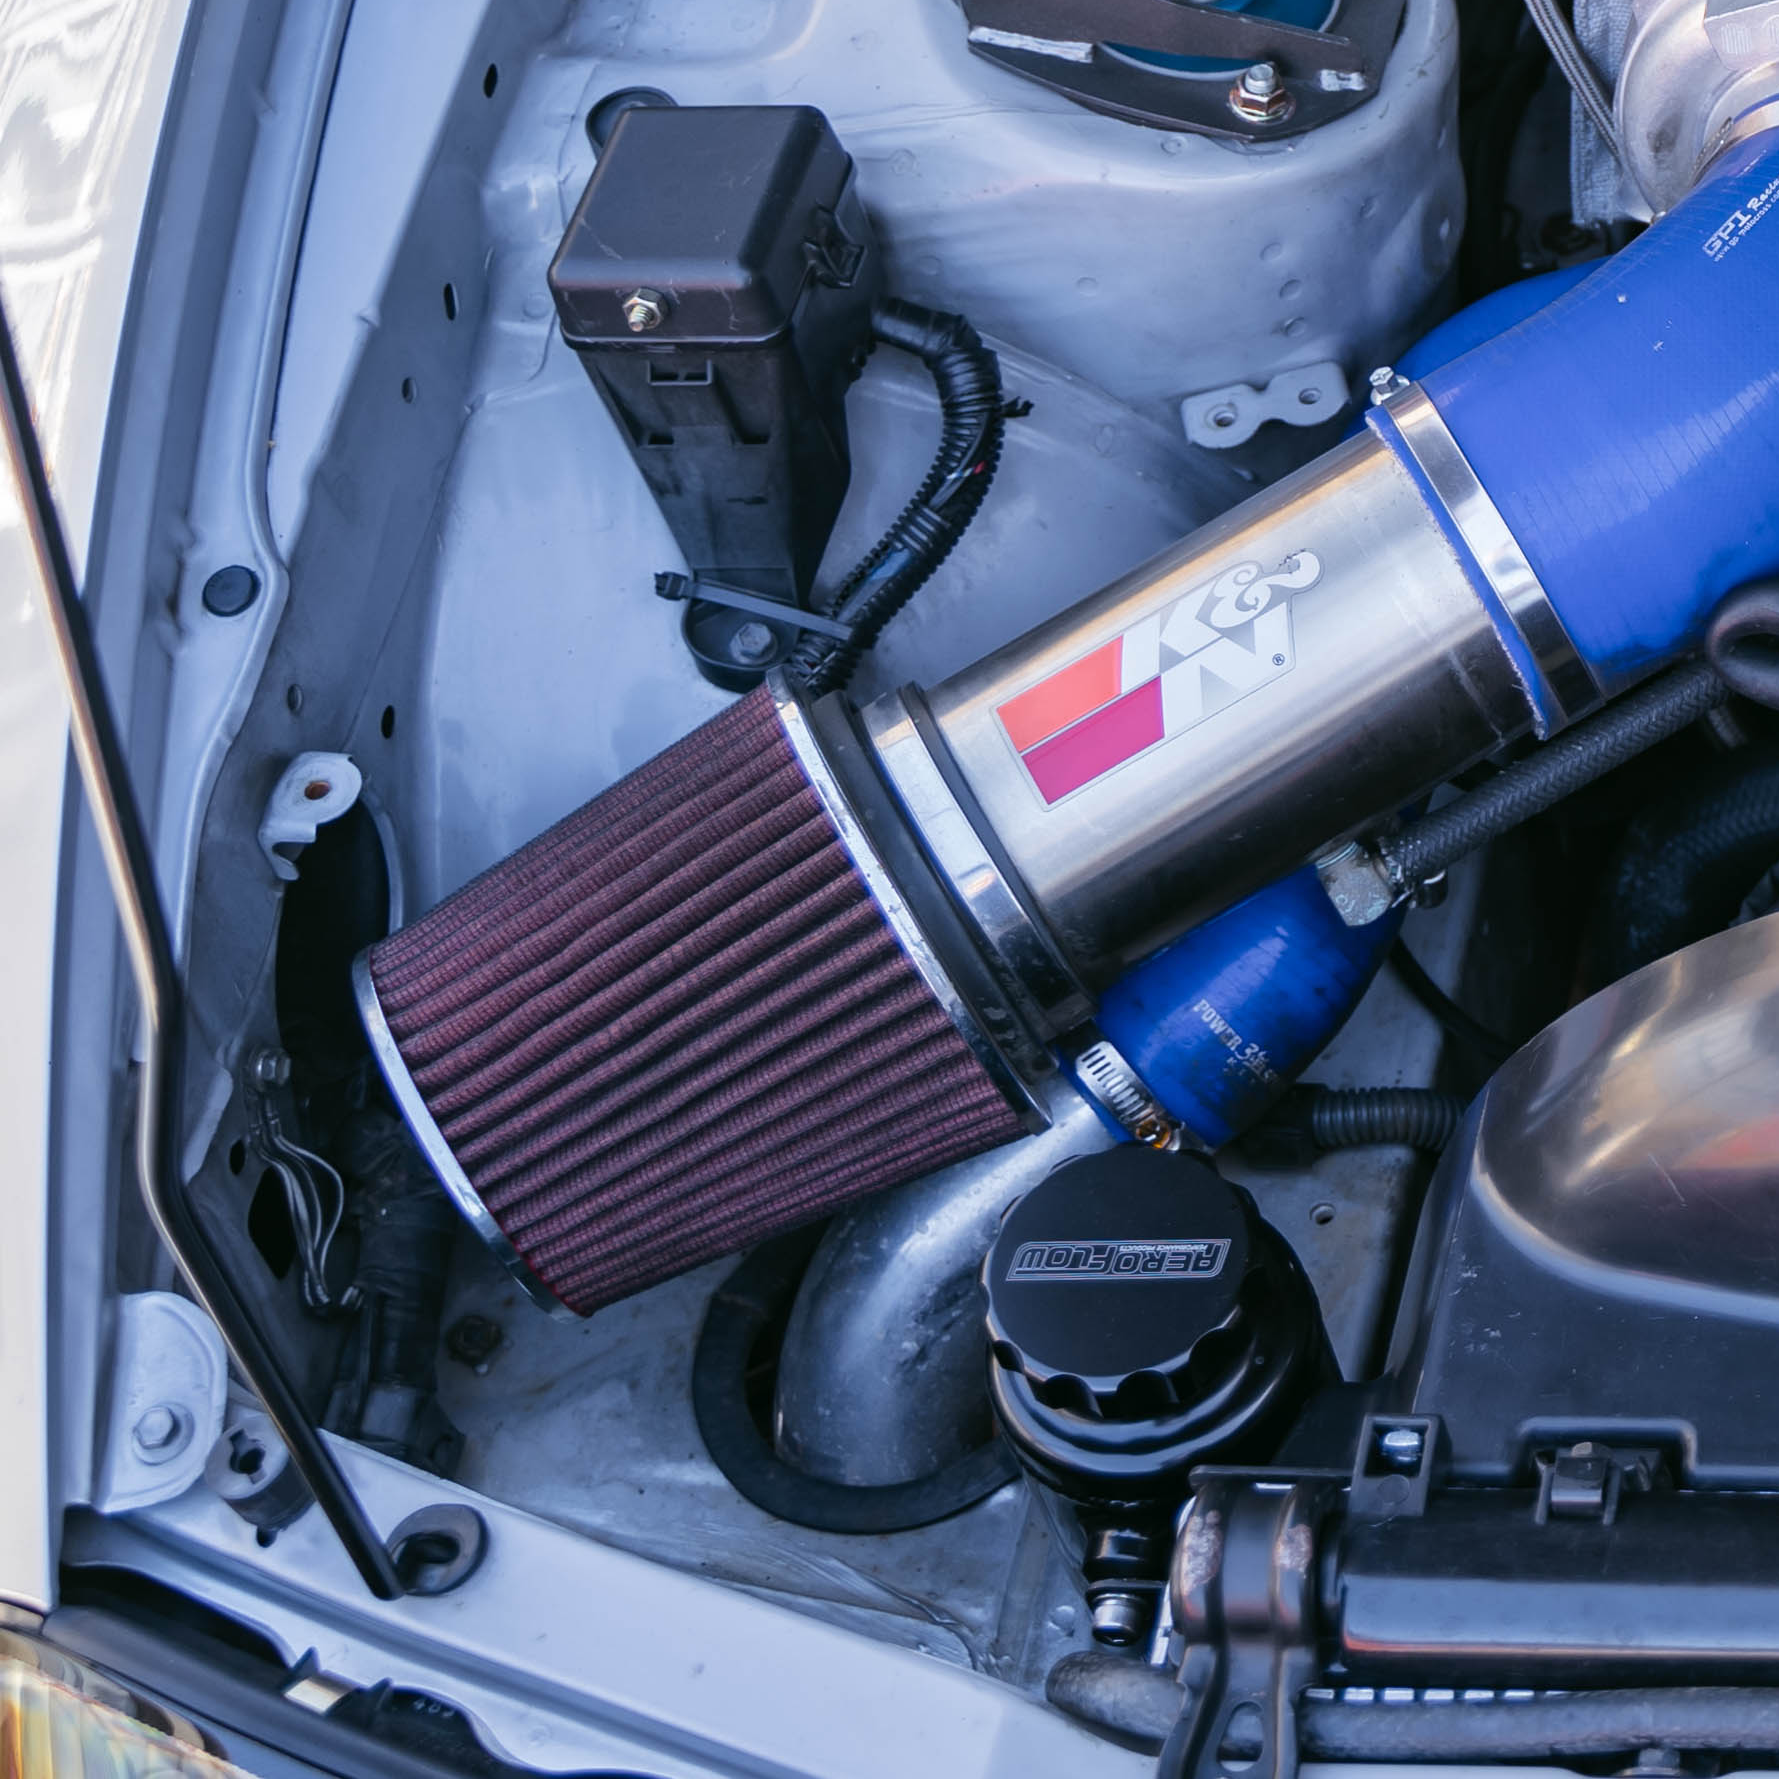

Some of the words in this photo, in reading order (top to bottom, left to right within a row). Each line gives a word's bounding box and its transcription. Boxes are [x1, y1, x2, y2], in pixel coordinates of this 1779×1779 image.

[1702, 209, 1752, 258] GPI
[1120, 551, 1321, 738] K&N
[1193, 999, 1243, 1052] POWER
[1019, 1242, 1222, 1275] AEROFLOW
[1156, 1244, 1208, 1252] PERFORMANCE
